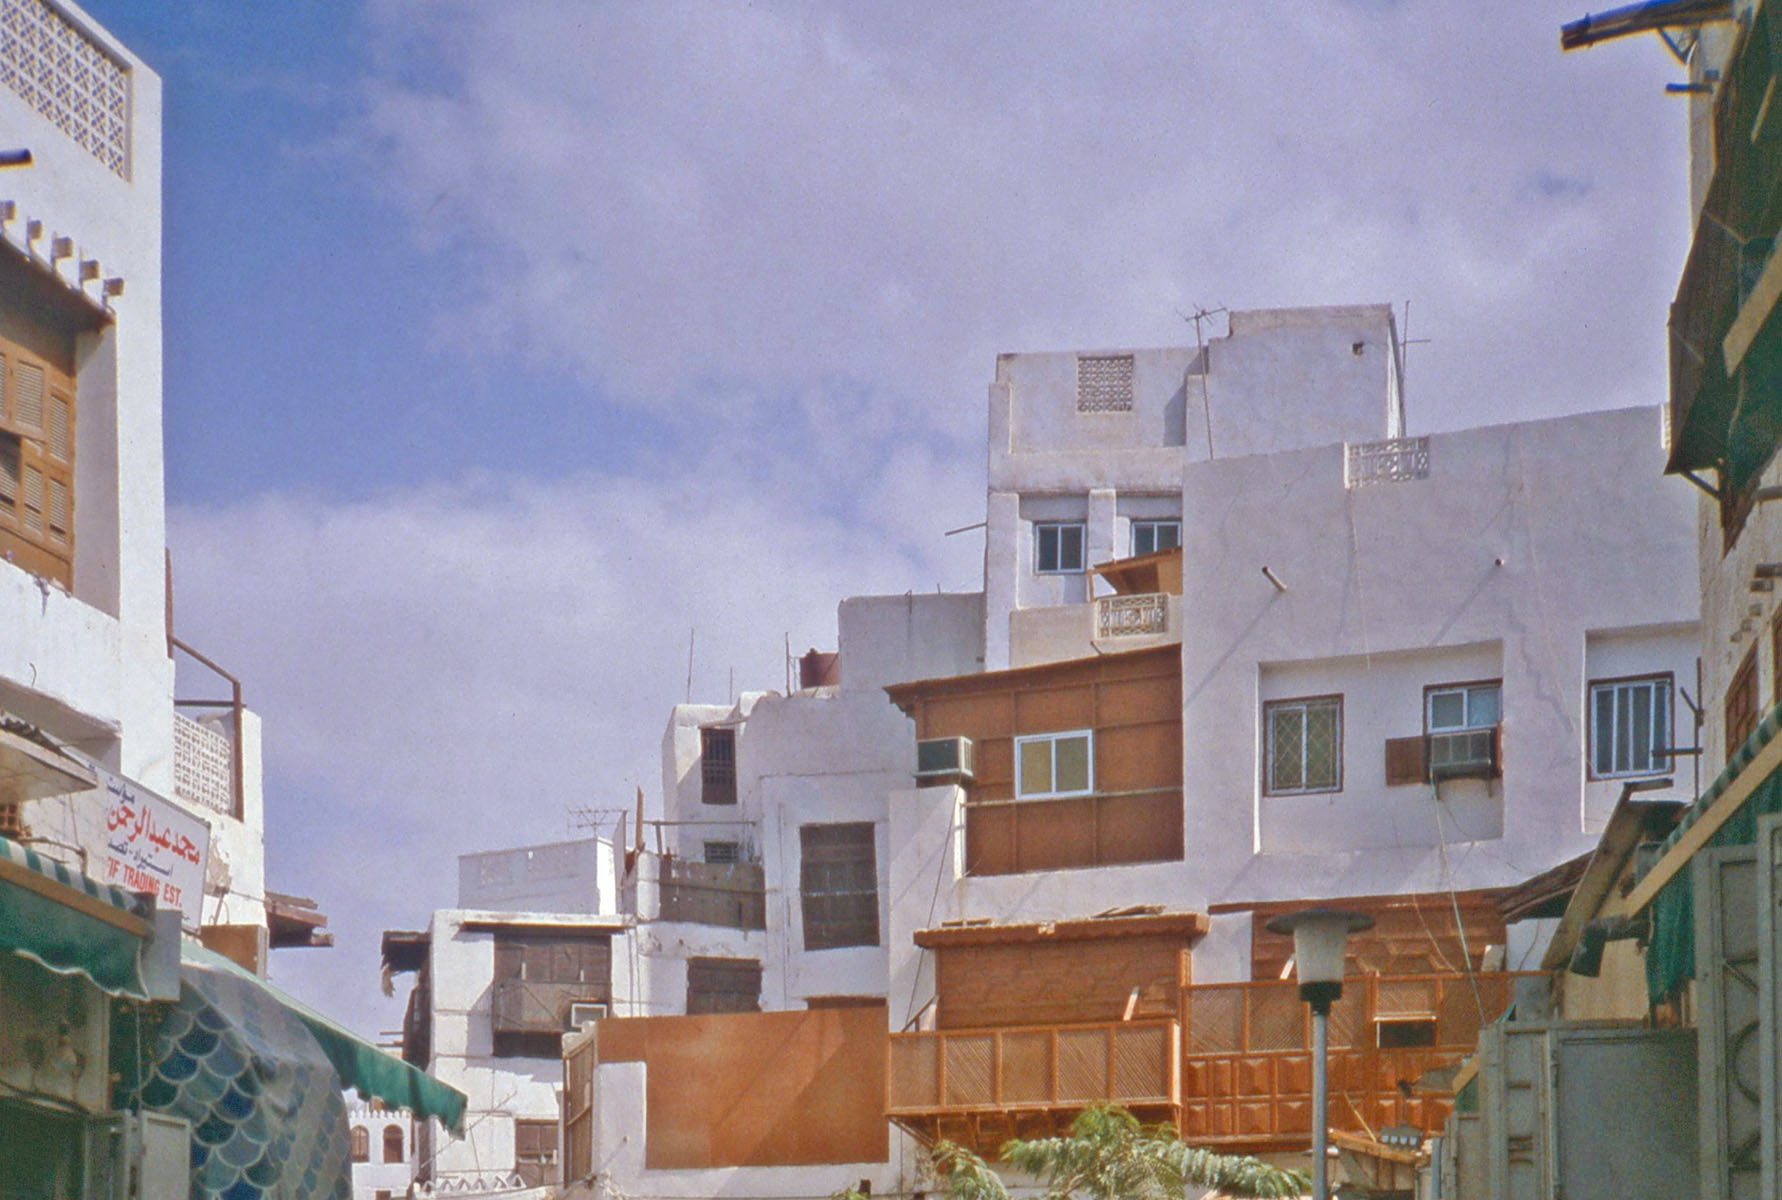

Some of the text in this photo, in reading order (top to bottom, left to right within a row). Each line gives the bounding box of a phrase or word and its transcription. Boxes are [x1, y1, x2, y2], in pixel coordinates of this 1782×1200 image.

[172, 834, 199, 864] محمد
[123, 864, 160, 894] TRADING
[163, 883, 182, 907] EST.
